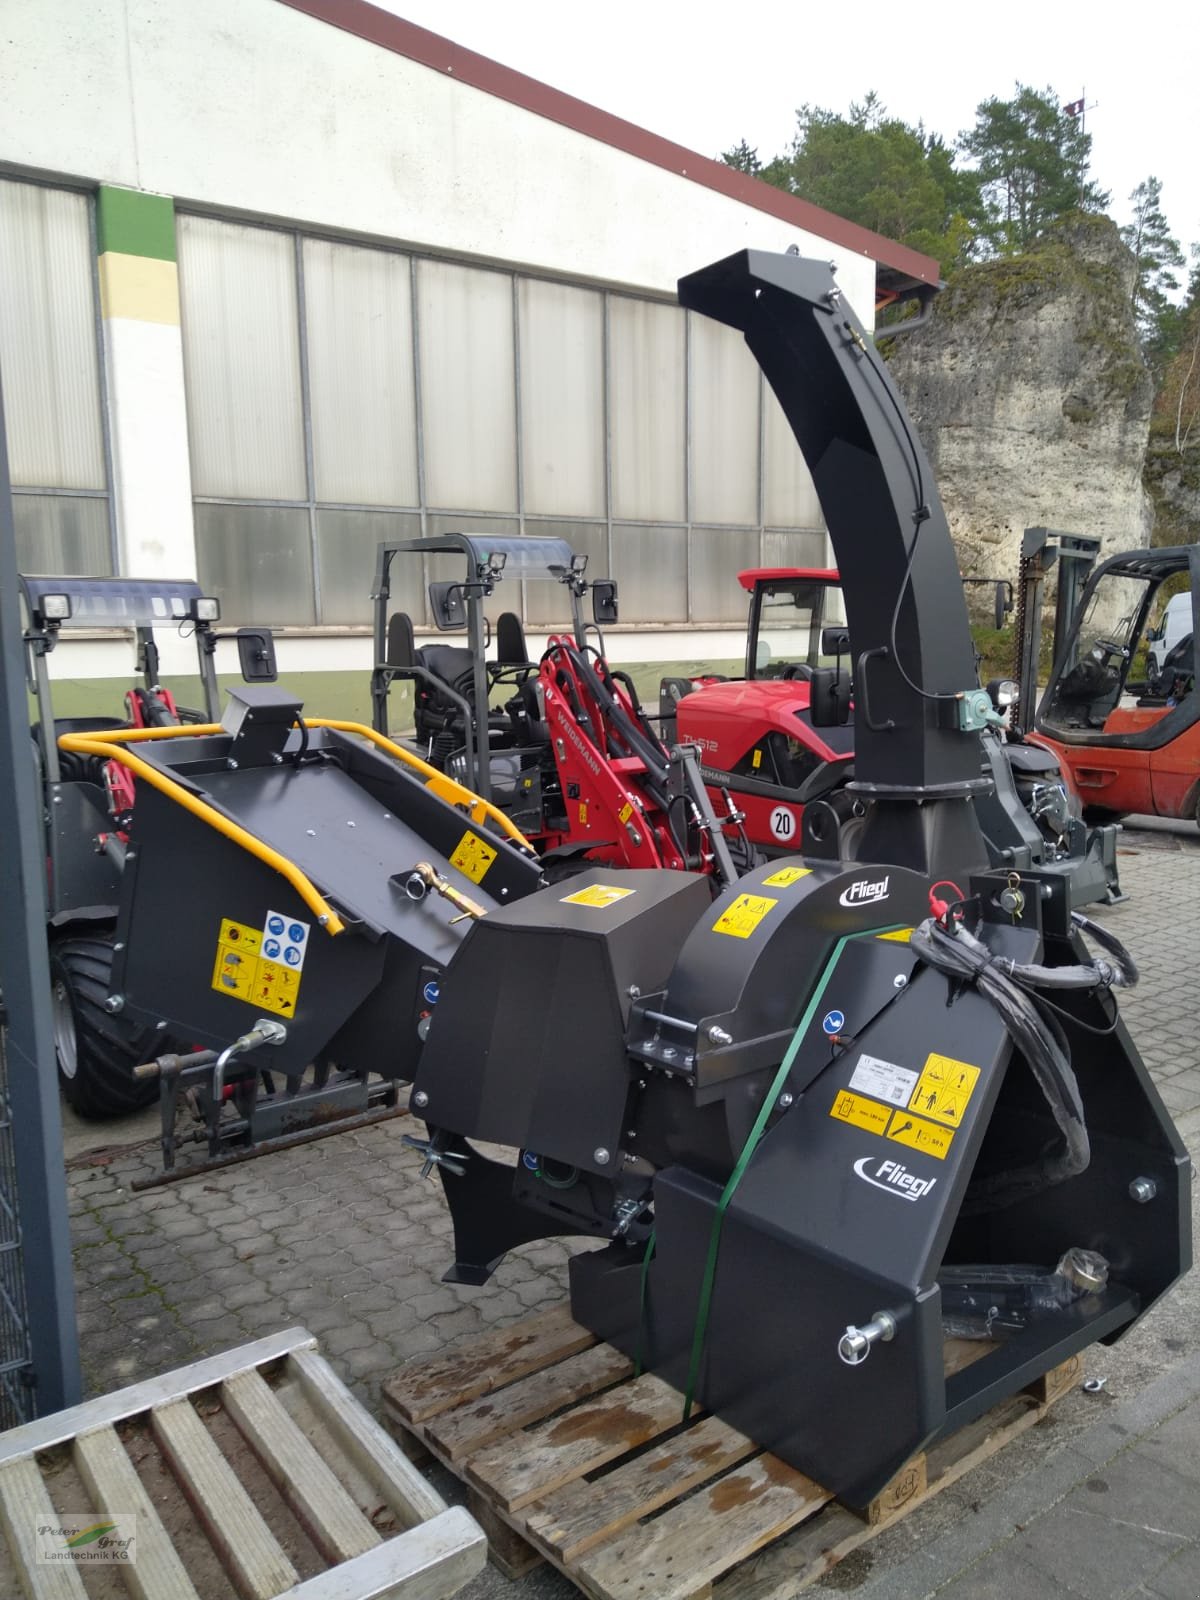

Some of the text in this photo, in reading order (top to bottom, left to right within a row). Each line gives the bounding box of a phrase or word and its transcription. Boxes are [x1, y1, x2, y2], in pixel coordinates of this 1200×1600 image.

[557, 710, 601, 776] WEIDEMANN
[700, 769, 730, 783] DEMANN
[775, 812, 791, 834] 20
[850, 876, 889, 900] Fliegl
[875, 1159, 937, 1198] Fliegl
